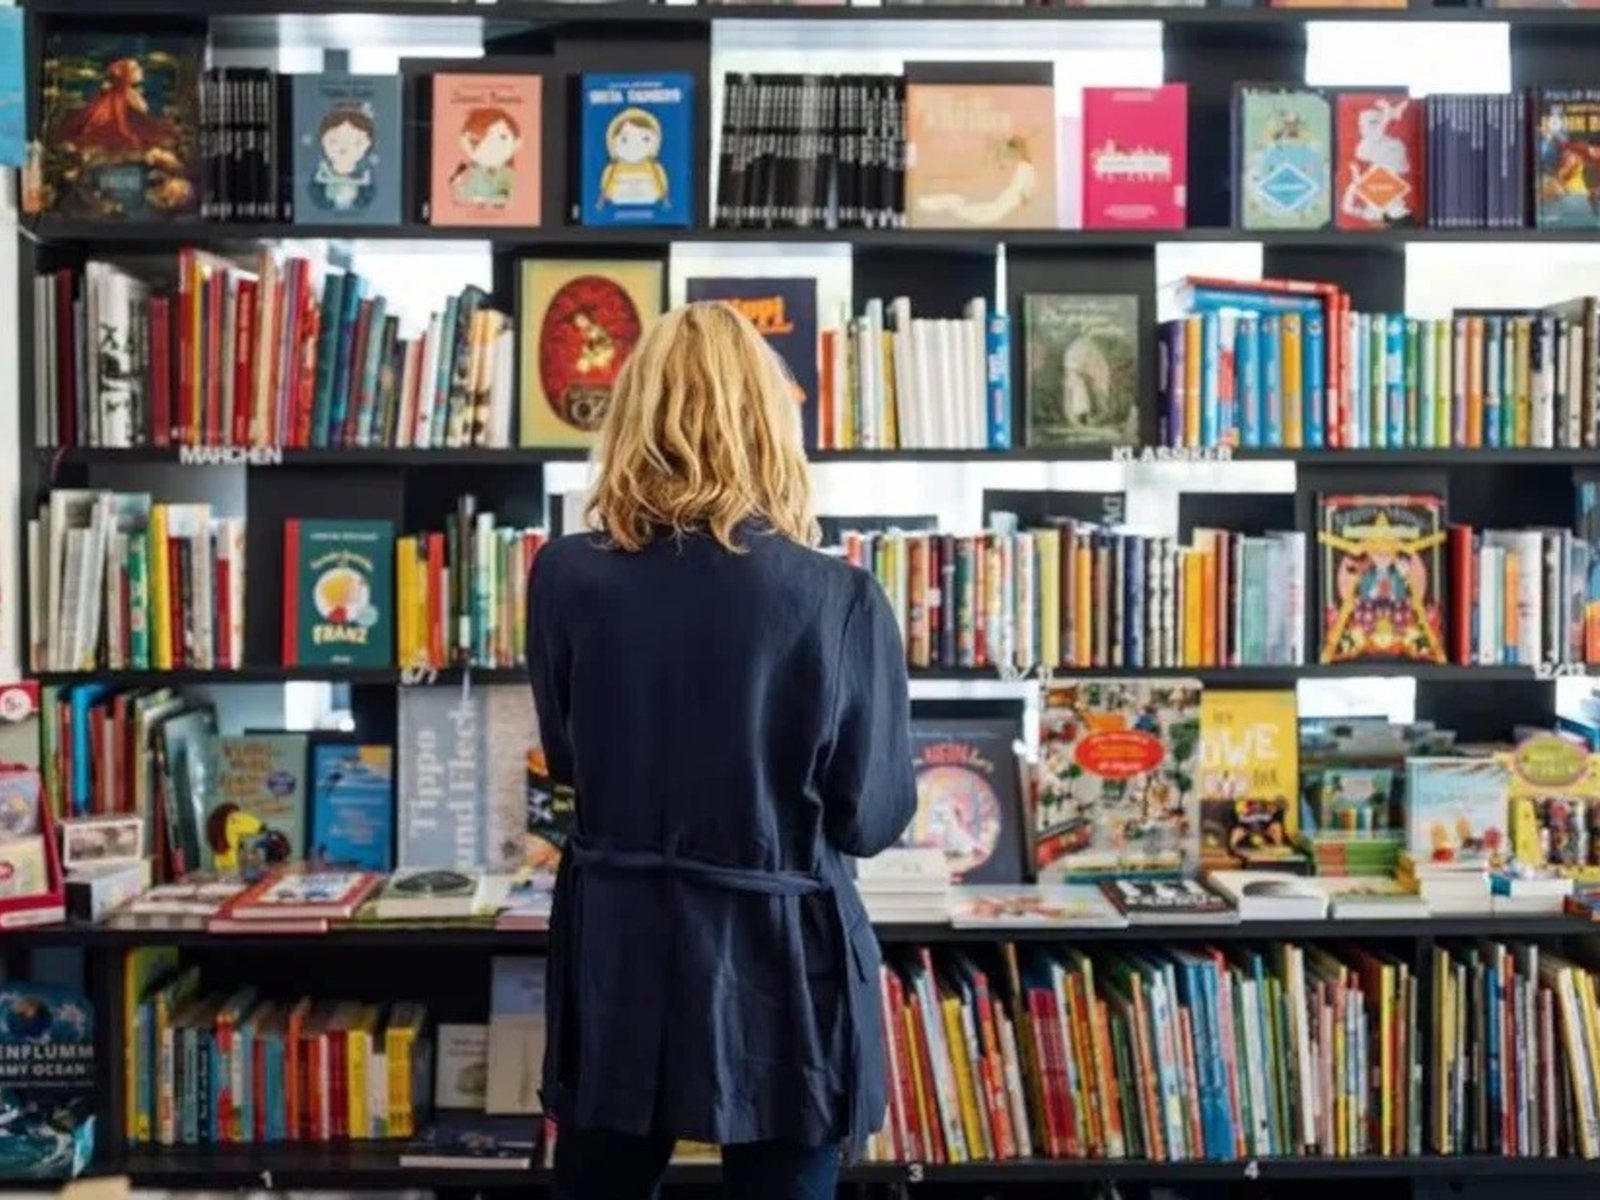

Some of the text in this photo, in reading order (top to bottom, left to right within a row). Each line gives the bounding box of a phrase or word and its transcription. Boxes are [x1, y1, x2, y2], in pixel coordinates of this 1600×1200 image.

[260, 1169, 273, 1188] 1
[909, 1163, 924, 1183] 3
[1244, 1159, 1260, 1180] 4
